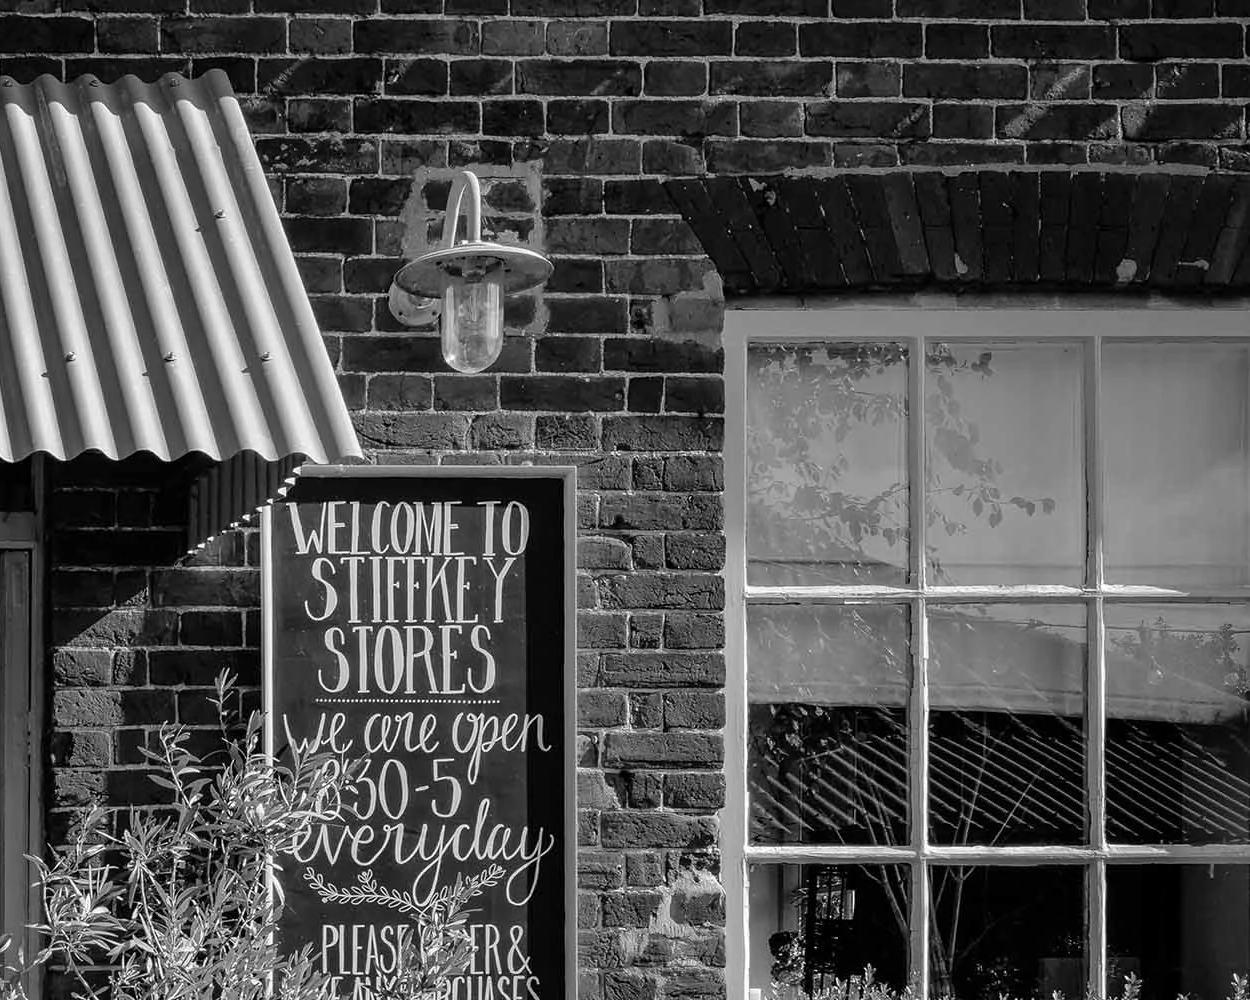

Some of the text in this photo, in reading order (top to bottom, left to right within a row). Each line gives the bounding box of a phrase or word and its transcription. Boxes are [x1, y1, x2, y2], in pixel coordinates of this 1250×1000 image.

[285, 500, 530, 556] WELCOME TO
[304, 557, 517, 624] STIFFKEY
[317, 625, 496, 694] STORES
[364, 711, 440, 754] are
[452, 712, 552, 785] open
[285, 798, 554, 906] everyday
[507, 925, 533, 975] &
